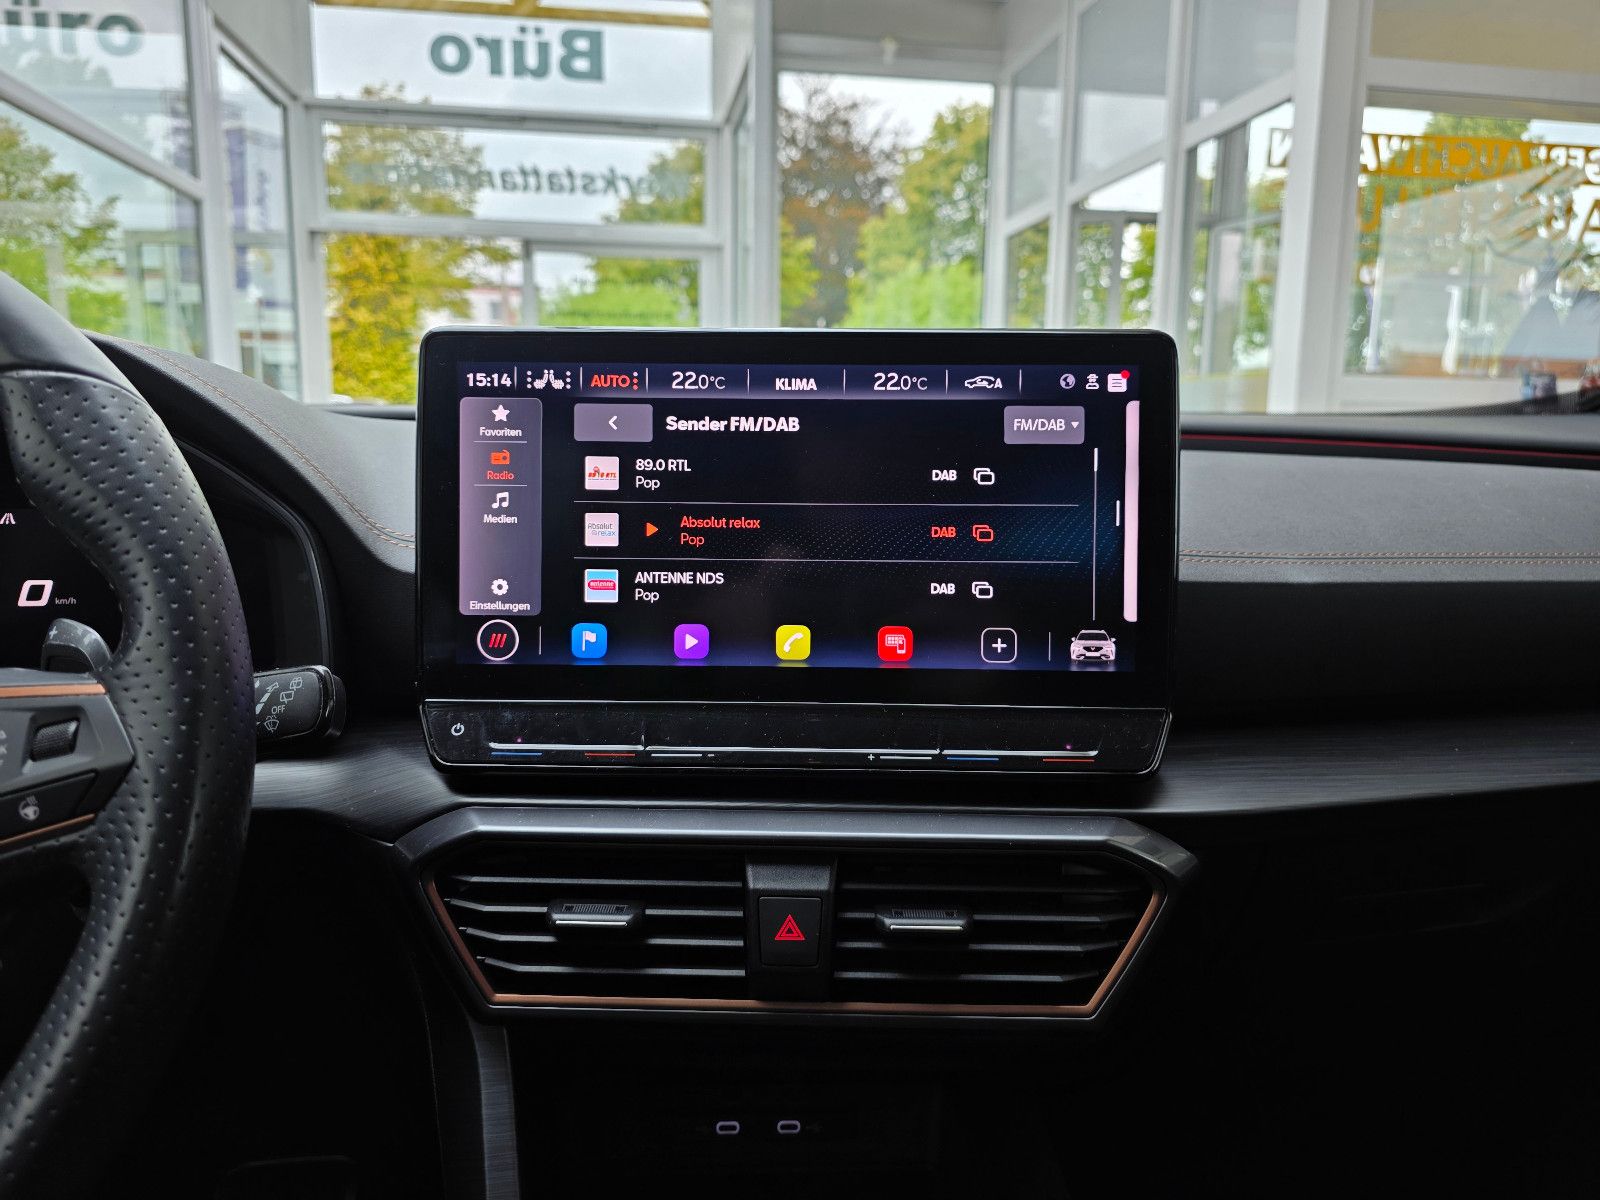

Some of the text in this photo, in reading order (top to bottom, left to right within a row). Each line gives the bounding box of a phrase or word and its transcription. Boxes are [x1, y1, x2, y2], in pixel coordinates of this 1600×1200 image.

[466, 372, 512, 388] 15:14
[590, 374, 631, 388] AUTO
[775, 377, 818, 391] KLIMA
[665, 415, 800, 433] Sender FM/DAB
[1013, 418, 1066, 432] FM/DAB
[479, 427, 523, 438] Favoriten
[635, 458, 692, 473] 89.0 RTL
[486, 470, 515, 481] Radio
[931, 469, 958, 482] DAB
[635, 475, 661, 491] Pop
[483, 513, 518, 525] Medien
[680, 515, 761, 530] Absolut relax
[931, 525, 957, 538] DAB
[680, 532, 705, 548] Pop
[634, 571, 725, 585] ANTENNE NDS
[17, 579, 54, 607] 0
[930, 582, 956, 595] DAB
[54, 597, 77, 606] km/h
[634, 588, 660, 604] Pop
[469, 600, 531, 612] Einstellungen
[271, 705, 286, 714] OFF
